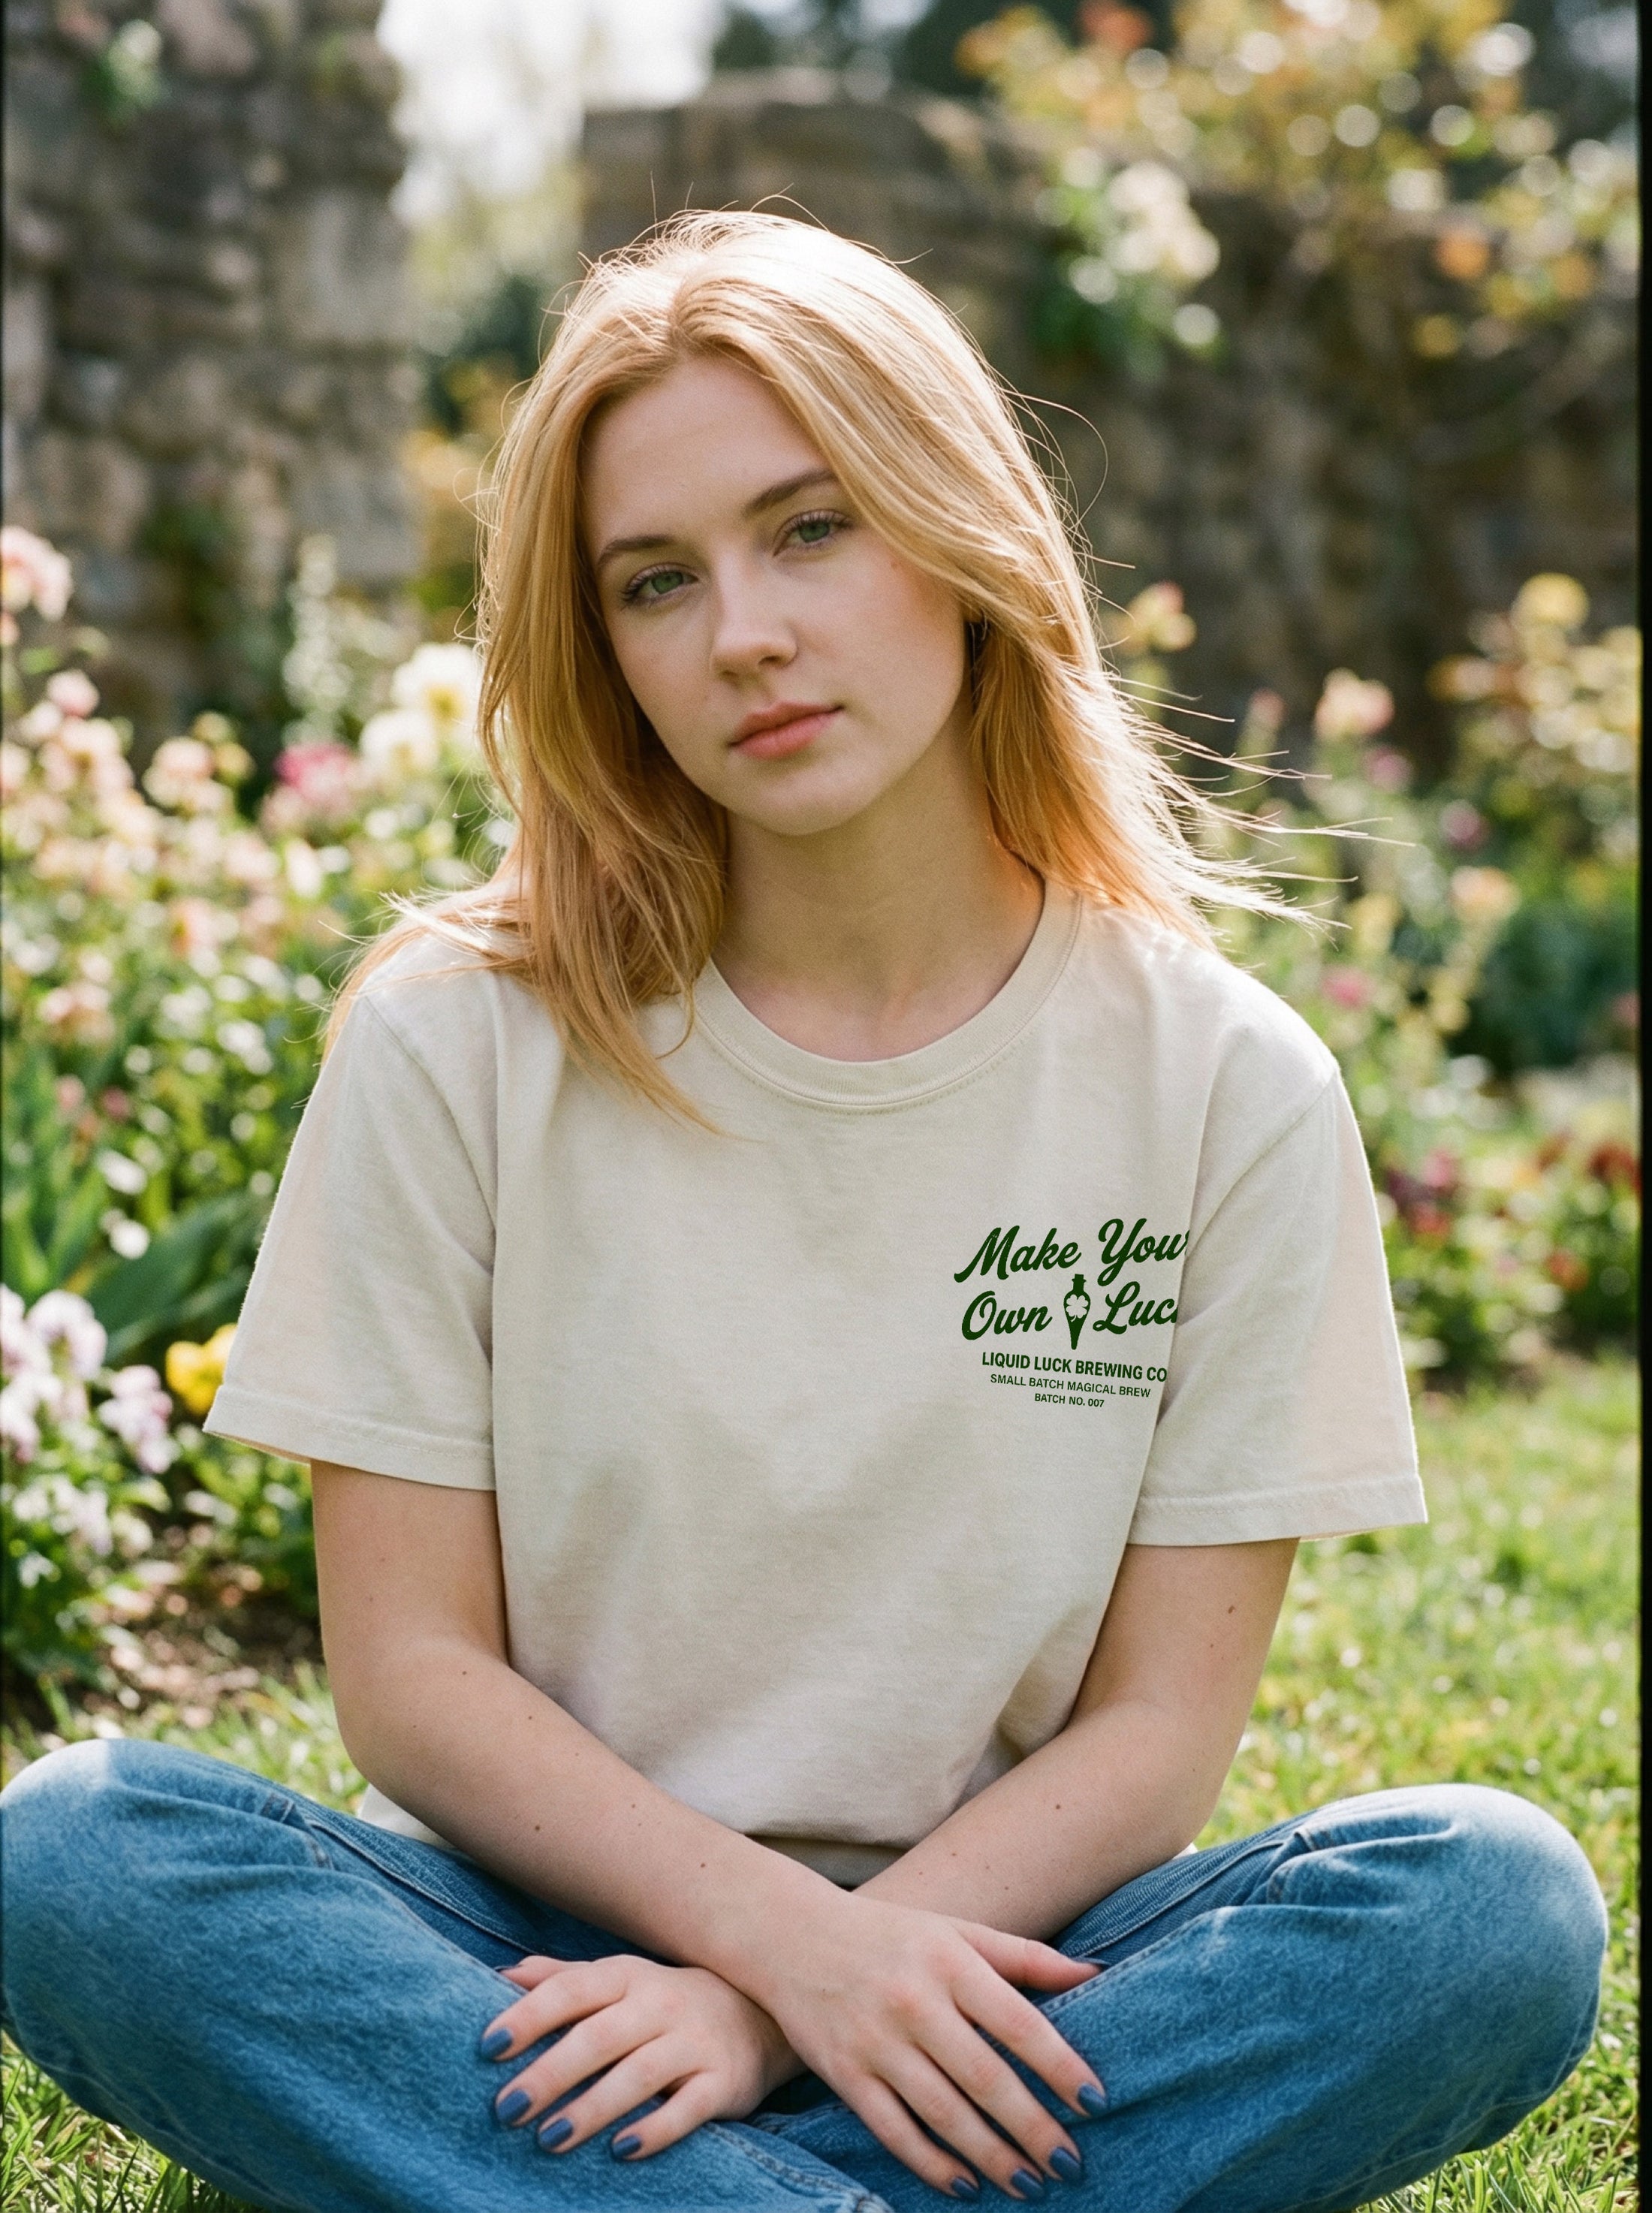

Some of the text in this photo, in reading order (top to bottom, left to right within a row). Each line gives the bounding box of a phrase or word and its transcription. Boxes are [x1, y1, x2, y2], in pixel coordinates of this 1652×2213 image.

[954, 1225, 1082, 1283] Make
[961, 1290, 1053, 1341] Own
[981, 1352, 1168, 1382] LIQUID LUCK BREWING CO
[990, 1373, 1151, 1397] SMALL BATCH MAGICAL BREW
[1034, 1393, 1105, 1408] BATCH NO. 007
